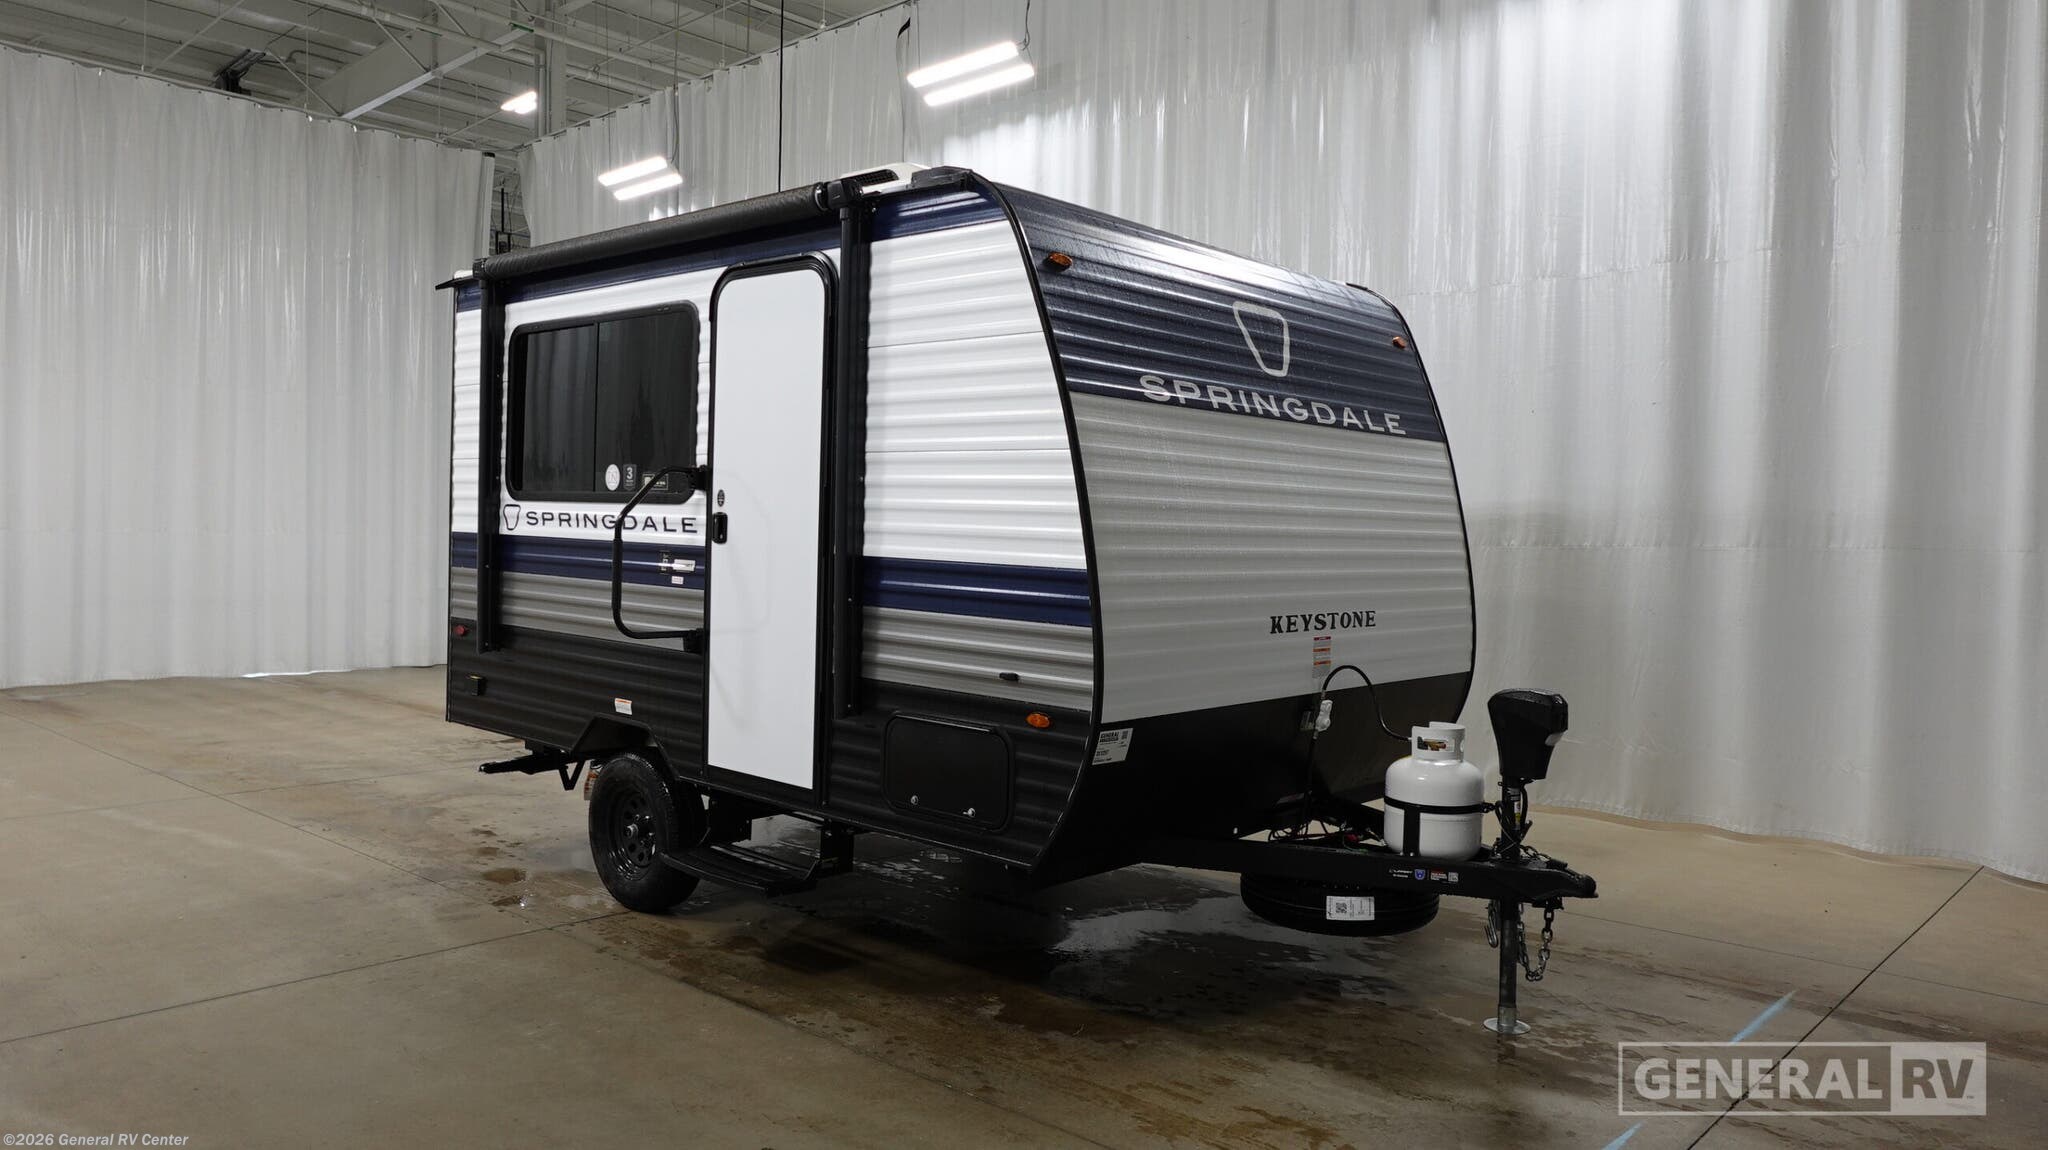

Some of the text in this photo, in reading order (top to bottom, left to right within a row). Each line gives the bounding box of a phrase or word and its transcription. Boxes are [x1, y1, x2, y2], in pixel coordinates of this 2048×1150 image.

[1139, 375, 1407, 435] SPRINGDALE
[626, 467, 633, 479] 3
[526, 511, 698, 533] SPRINGDALE
[1270, 611, 1376, 634] KEYSTONE
